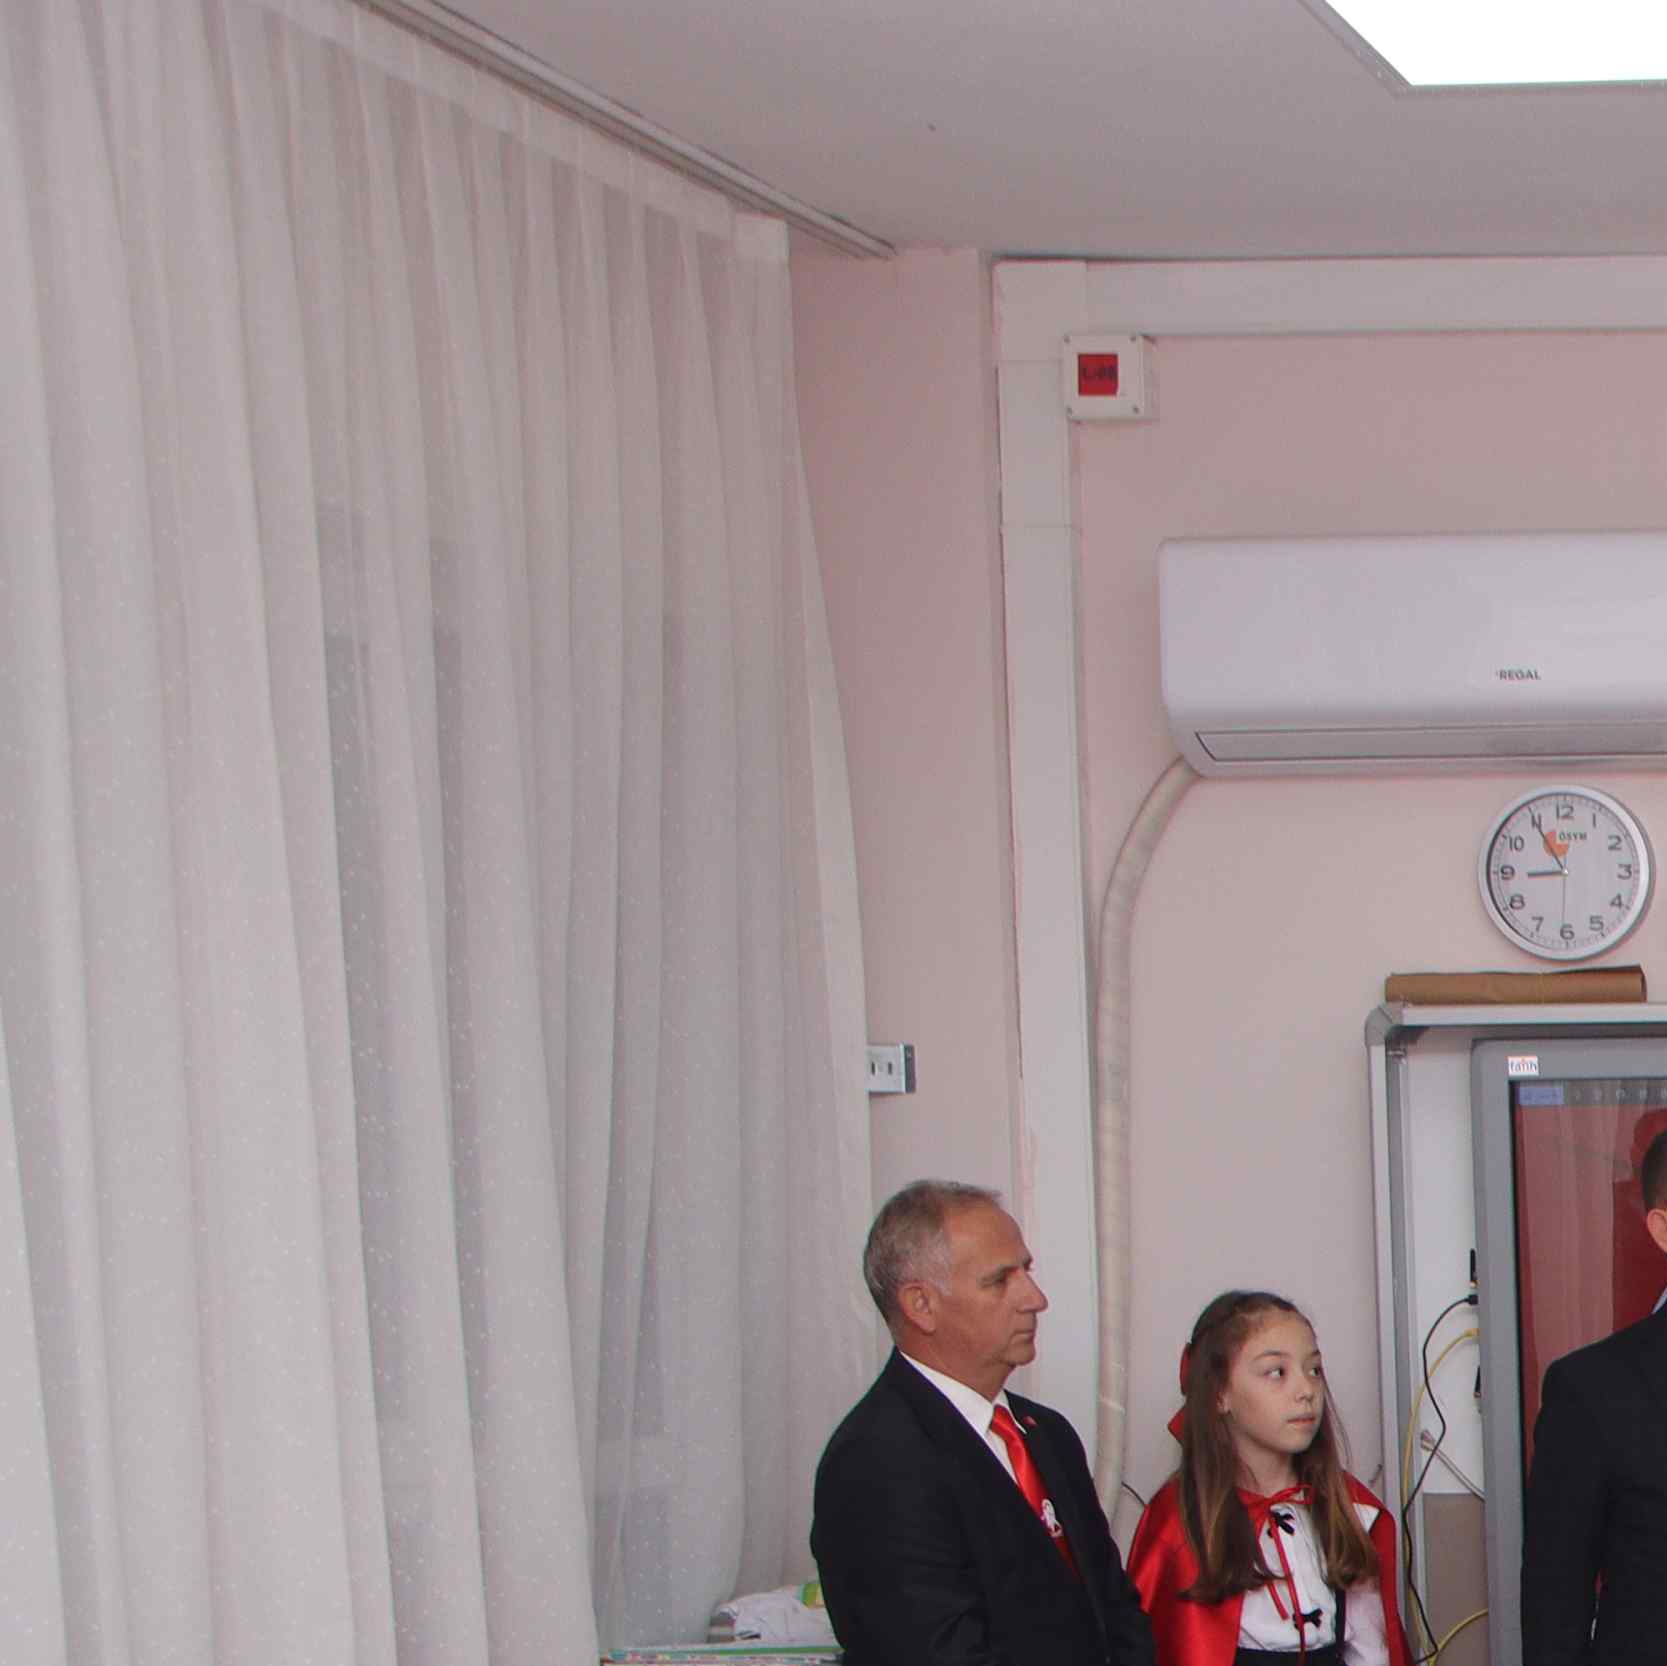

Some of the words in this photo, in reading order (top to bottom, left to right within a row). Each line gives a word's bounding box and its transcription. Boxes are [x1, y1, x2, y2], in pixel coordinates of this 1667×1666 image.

[1498, 668, 1541, 681] REGAL
[1556, 803, 1575, 821] 12
[1509, 835, 1525, 852] 10
[1607, 835, 1622, 850] 2
[1500, 865, 1515, 880] 9
[1617, 864, 1632, 880] 3
[1509, 893, 1526, 910] 8
[1609, 893, 1623, 910] 4
[1531, 916, 1544, 933] 7
[1559, 923, 1575, 940] 6
[1589, 915, 1605, 931] 5
